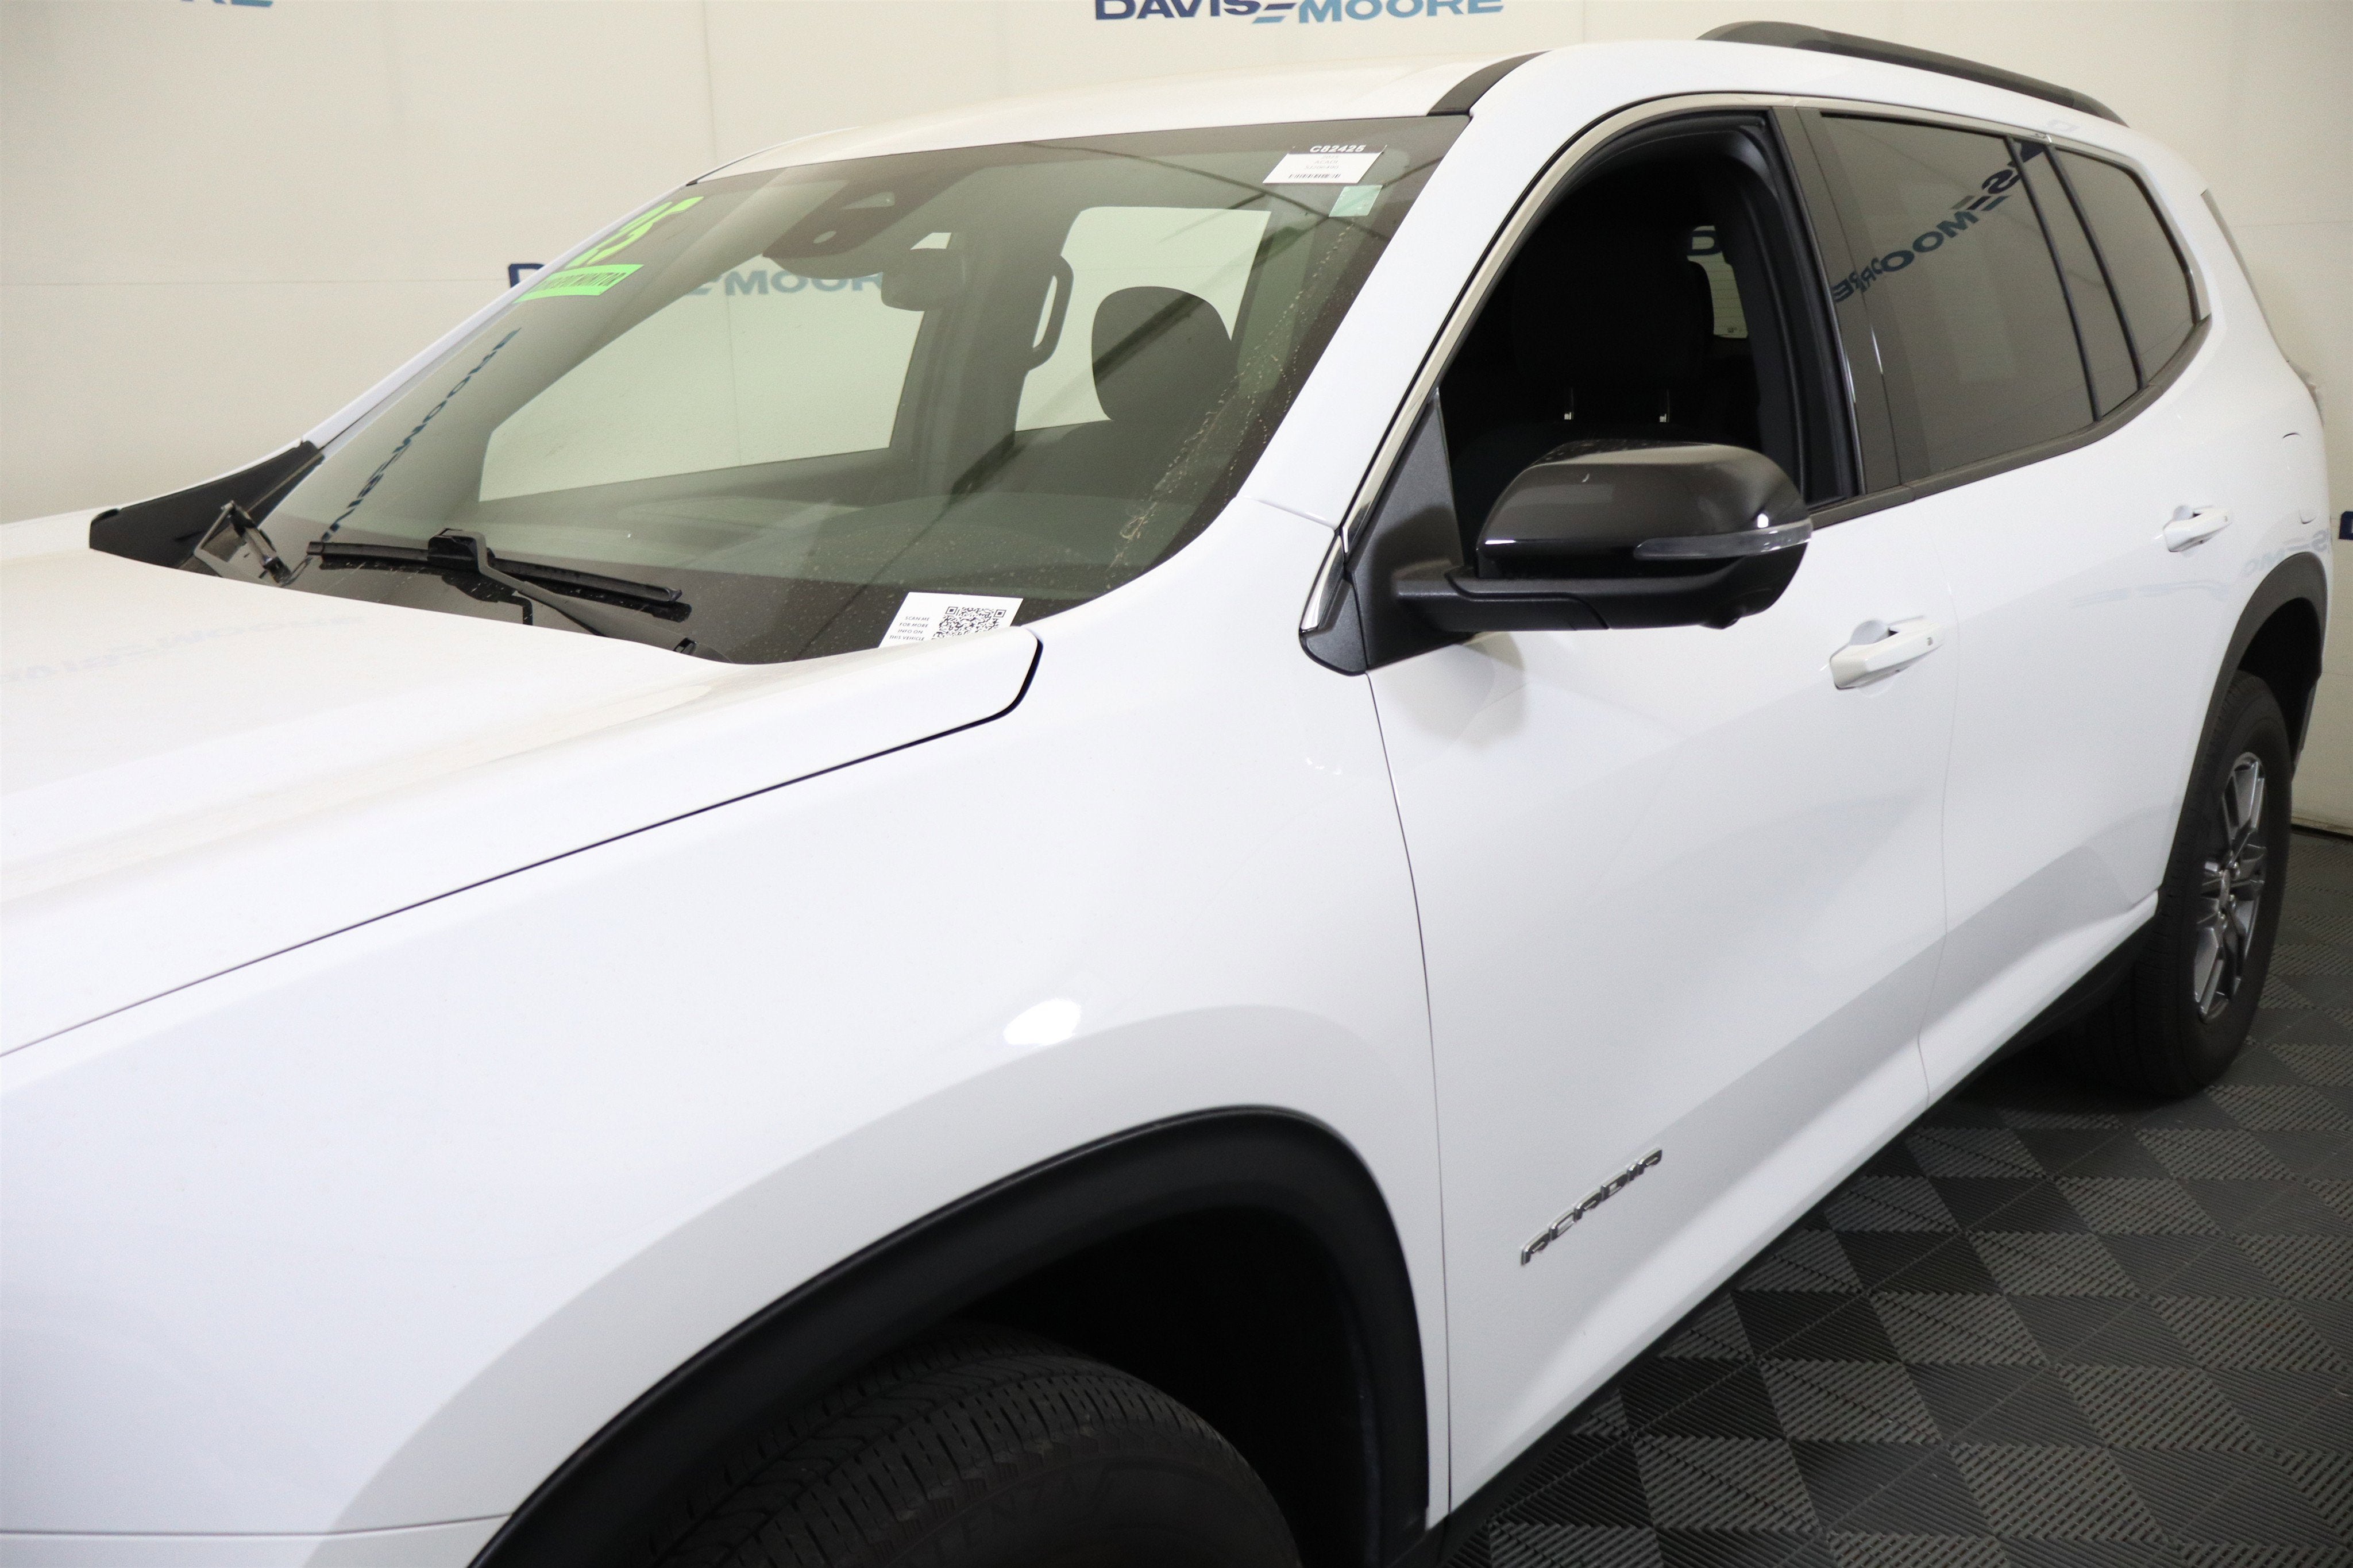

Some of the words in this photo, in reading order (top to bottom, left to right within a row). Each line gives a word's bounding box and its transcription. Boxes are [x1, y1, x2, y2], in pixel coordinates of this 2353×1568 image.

[1096, 0, 1261, 20] DAVIS
[1298, 0, 1505, 24] MOORE
[1310, 145, 1367, 153] C82425
